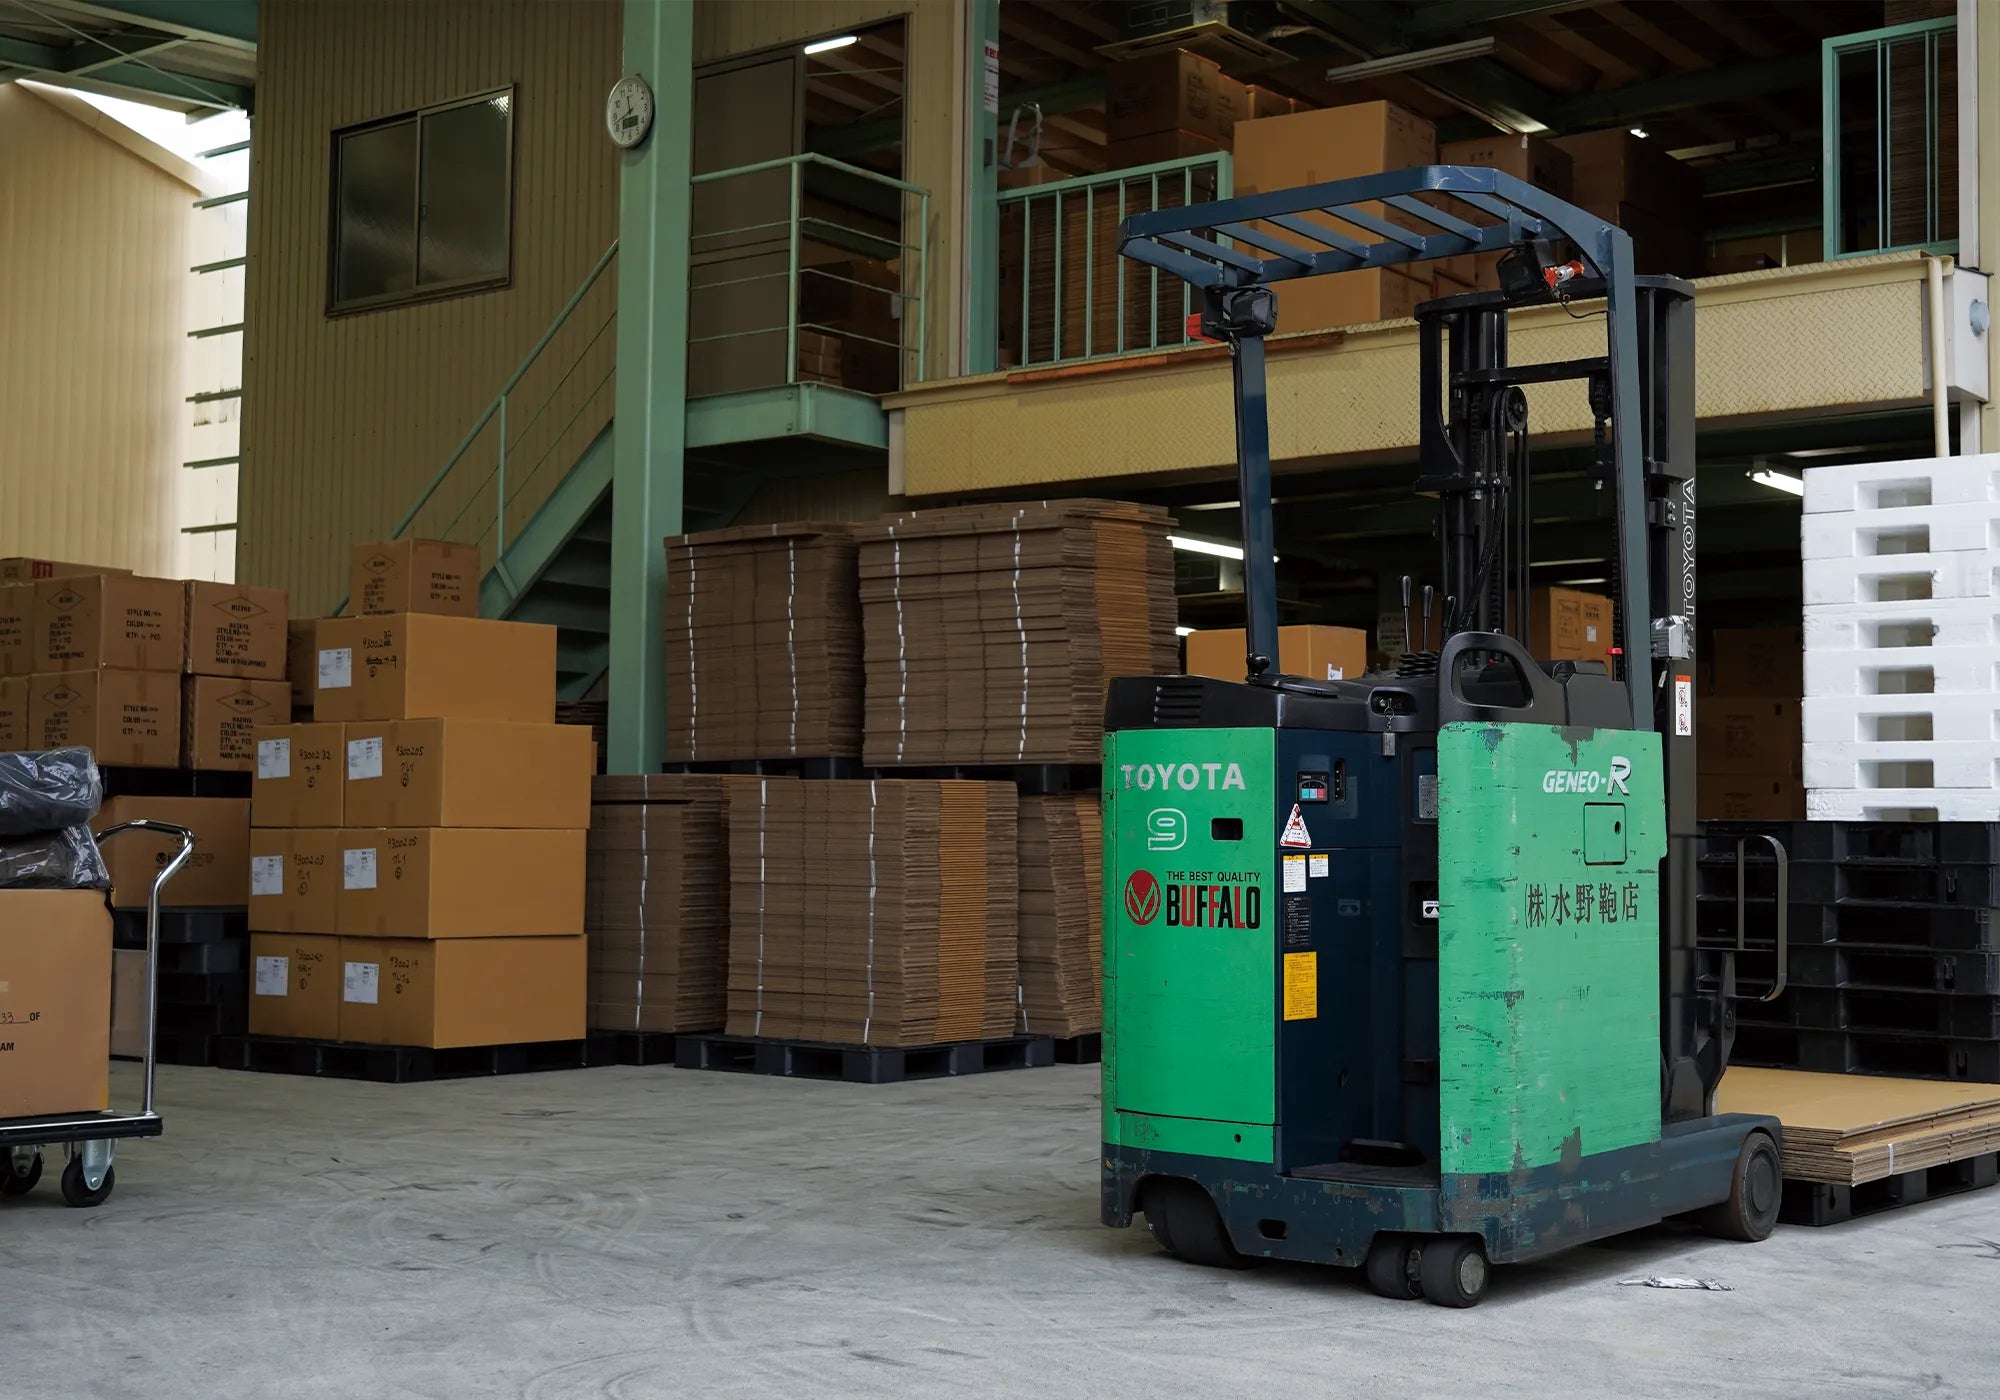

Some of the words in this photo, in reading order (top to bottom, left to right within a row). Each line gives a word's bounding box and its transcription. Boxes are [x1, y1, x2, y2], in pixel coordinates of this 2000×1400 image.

[1683, 477, 1695, 622] TOYOTA
[1120, 763, 1246, 791] TOYOTA
[1147, 807, 1187, 851] 9
[1166, 871, 1185, 881] THE
[1189, 871, 1213, 881] BEST
[1217, 872, 1261, 882] QUALITY
[1166, 884, 1261, 929] BUFFALO
[29, 1012, 41, 1022] OF
